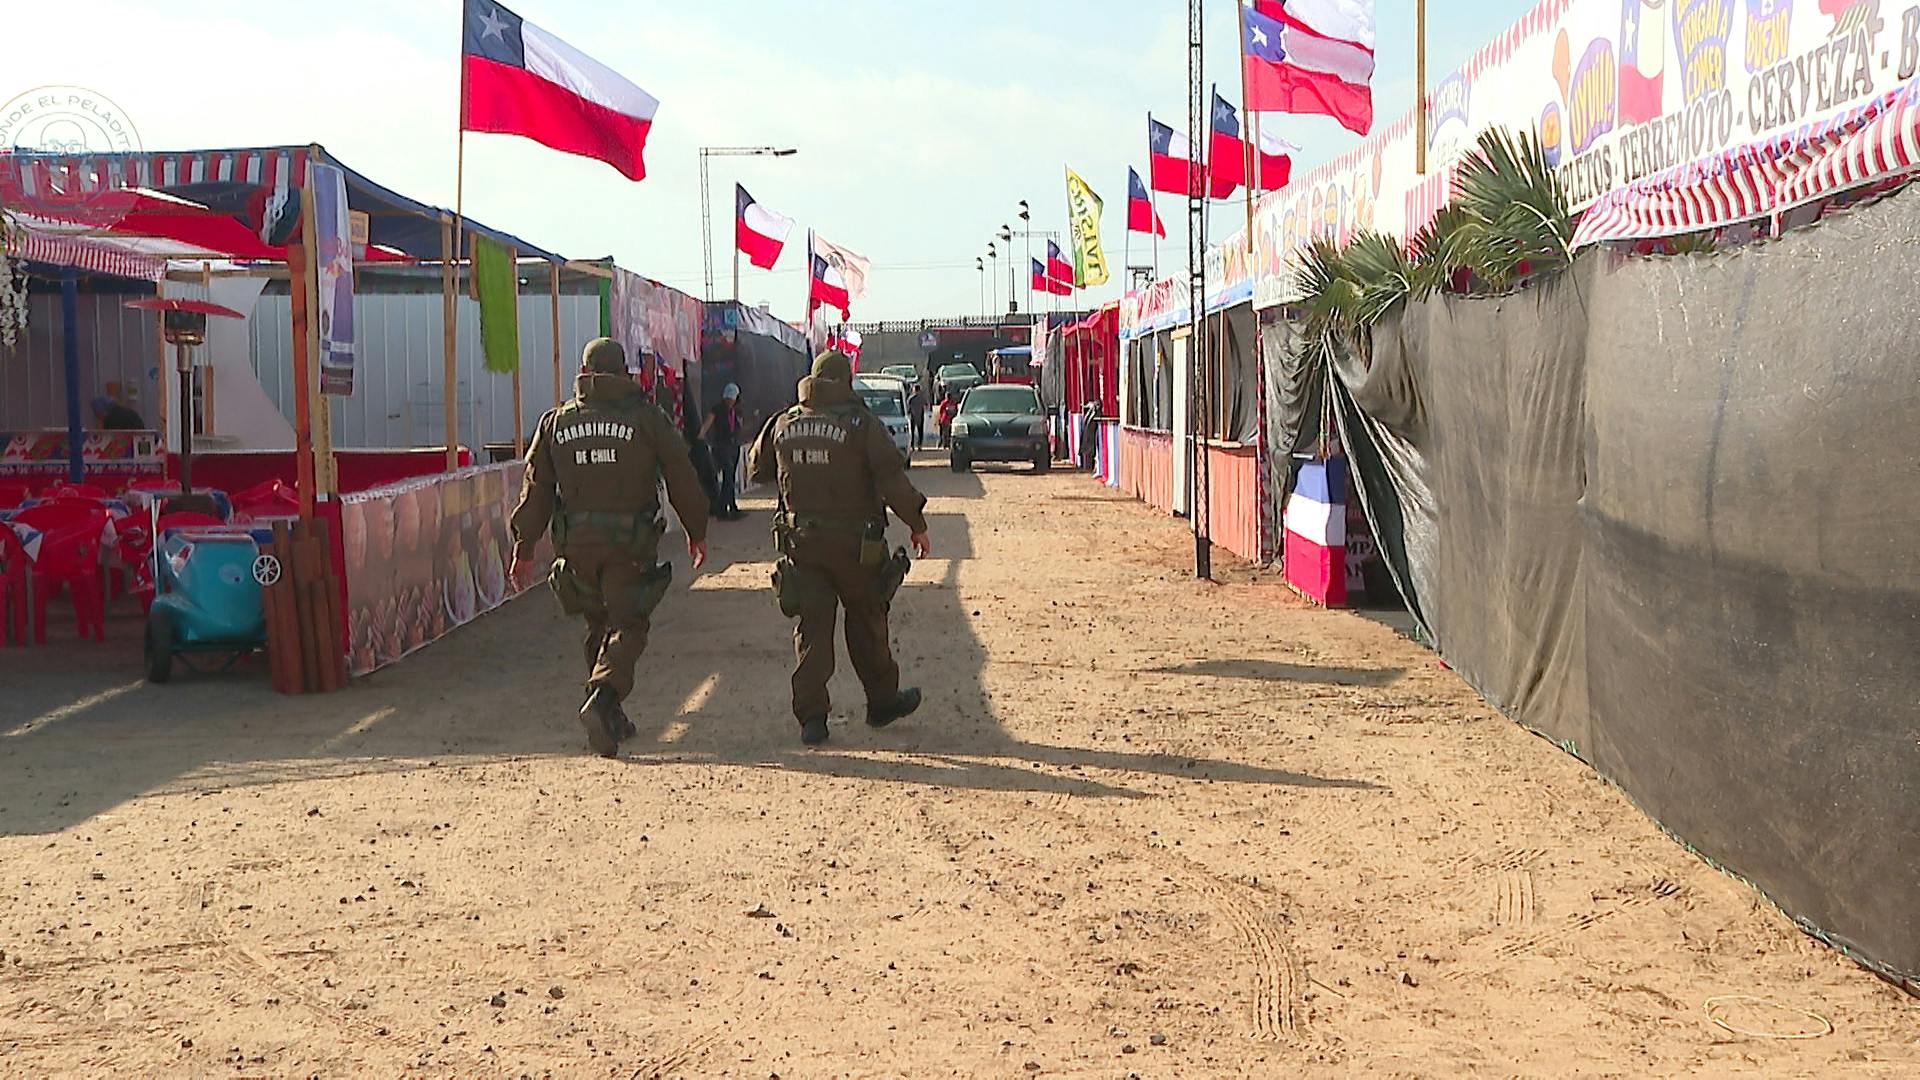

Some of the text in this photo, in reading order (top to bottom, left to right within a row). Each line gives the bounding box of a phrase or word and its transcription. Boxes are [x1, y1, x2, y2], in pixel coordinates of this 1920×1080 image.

[1685, 46, 1722, 104] COMER
[38, 95, 60, 108] EL
[1620, 88, 1733, 184] TERREMOTO
[1748, 27, 1874, 135] CERVEZA
[556, 421, 634, 445] CARABINEROS
[576, 448, 617, 465] DE CHILE
